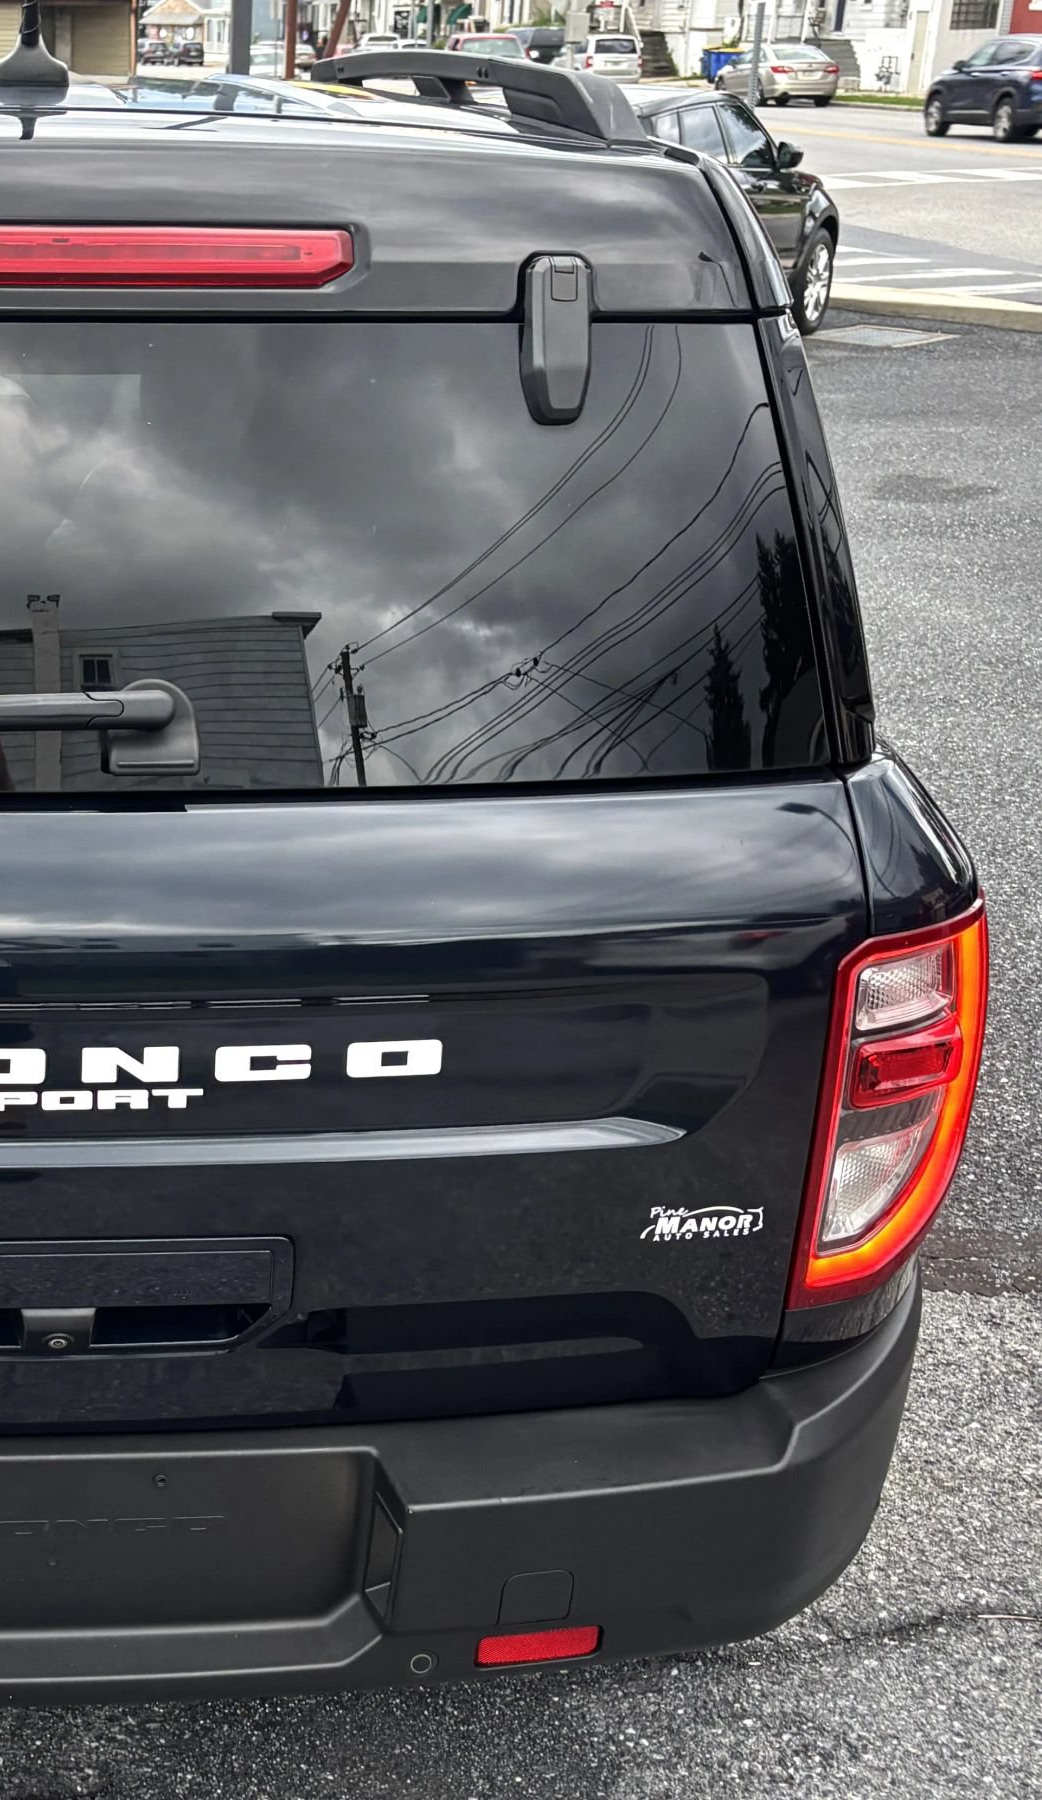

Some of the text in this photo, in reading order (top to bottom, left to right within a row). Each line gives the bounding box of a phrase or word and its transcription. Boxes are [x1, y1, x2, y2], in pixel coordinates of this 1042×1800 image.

[650, 1205, 688, 1219] Pine
[652, 1228, 750, 1242] AUTO SALES
